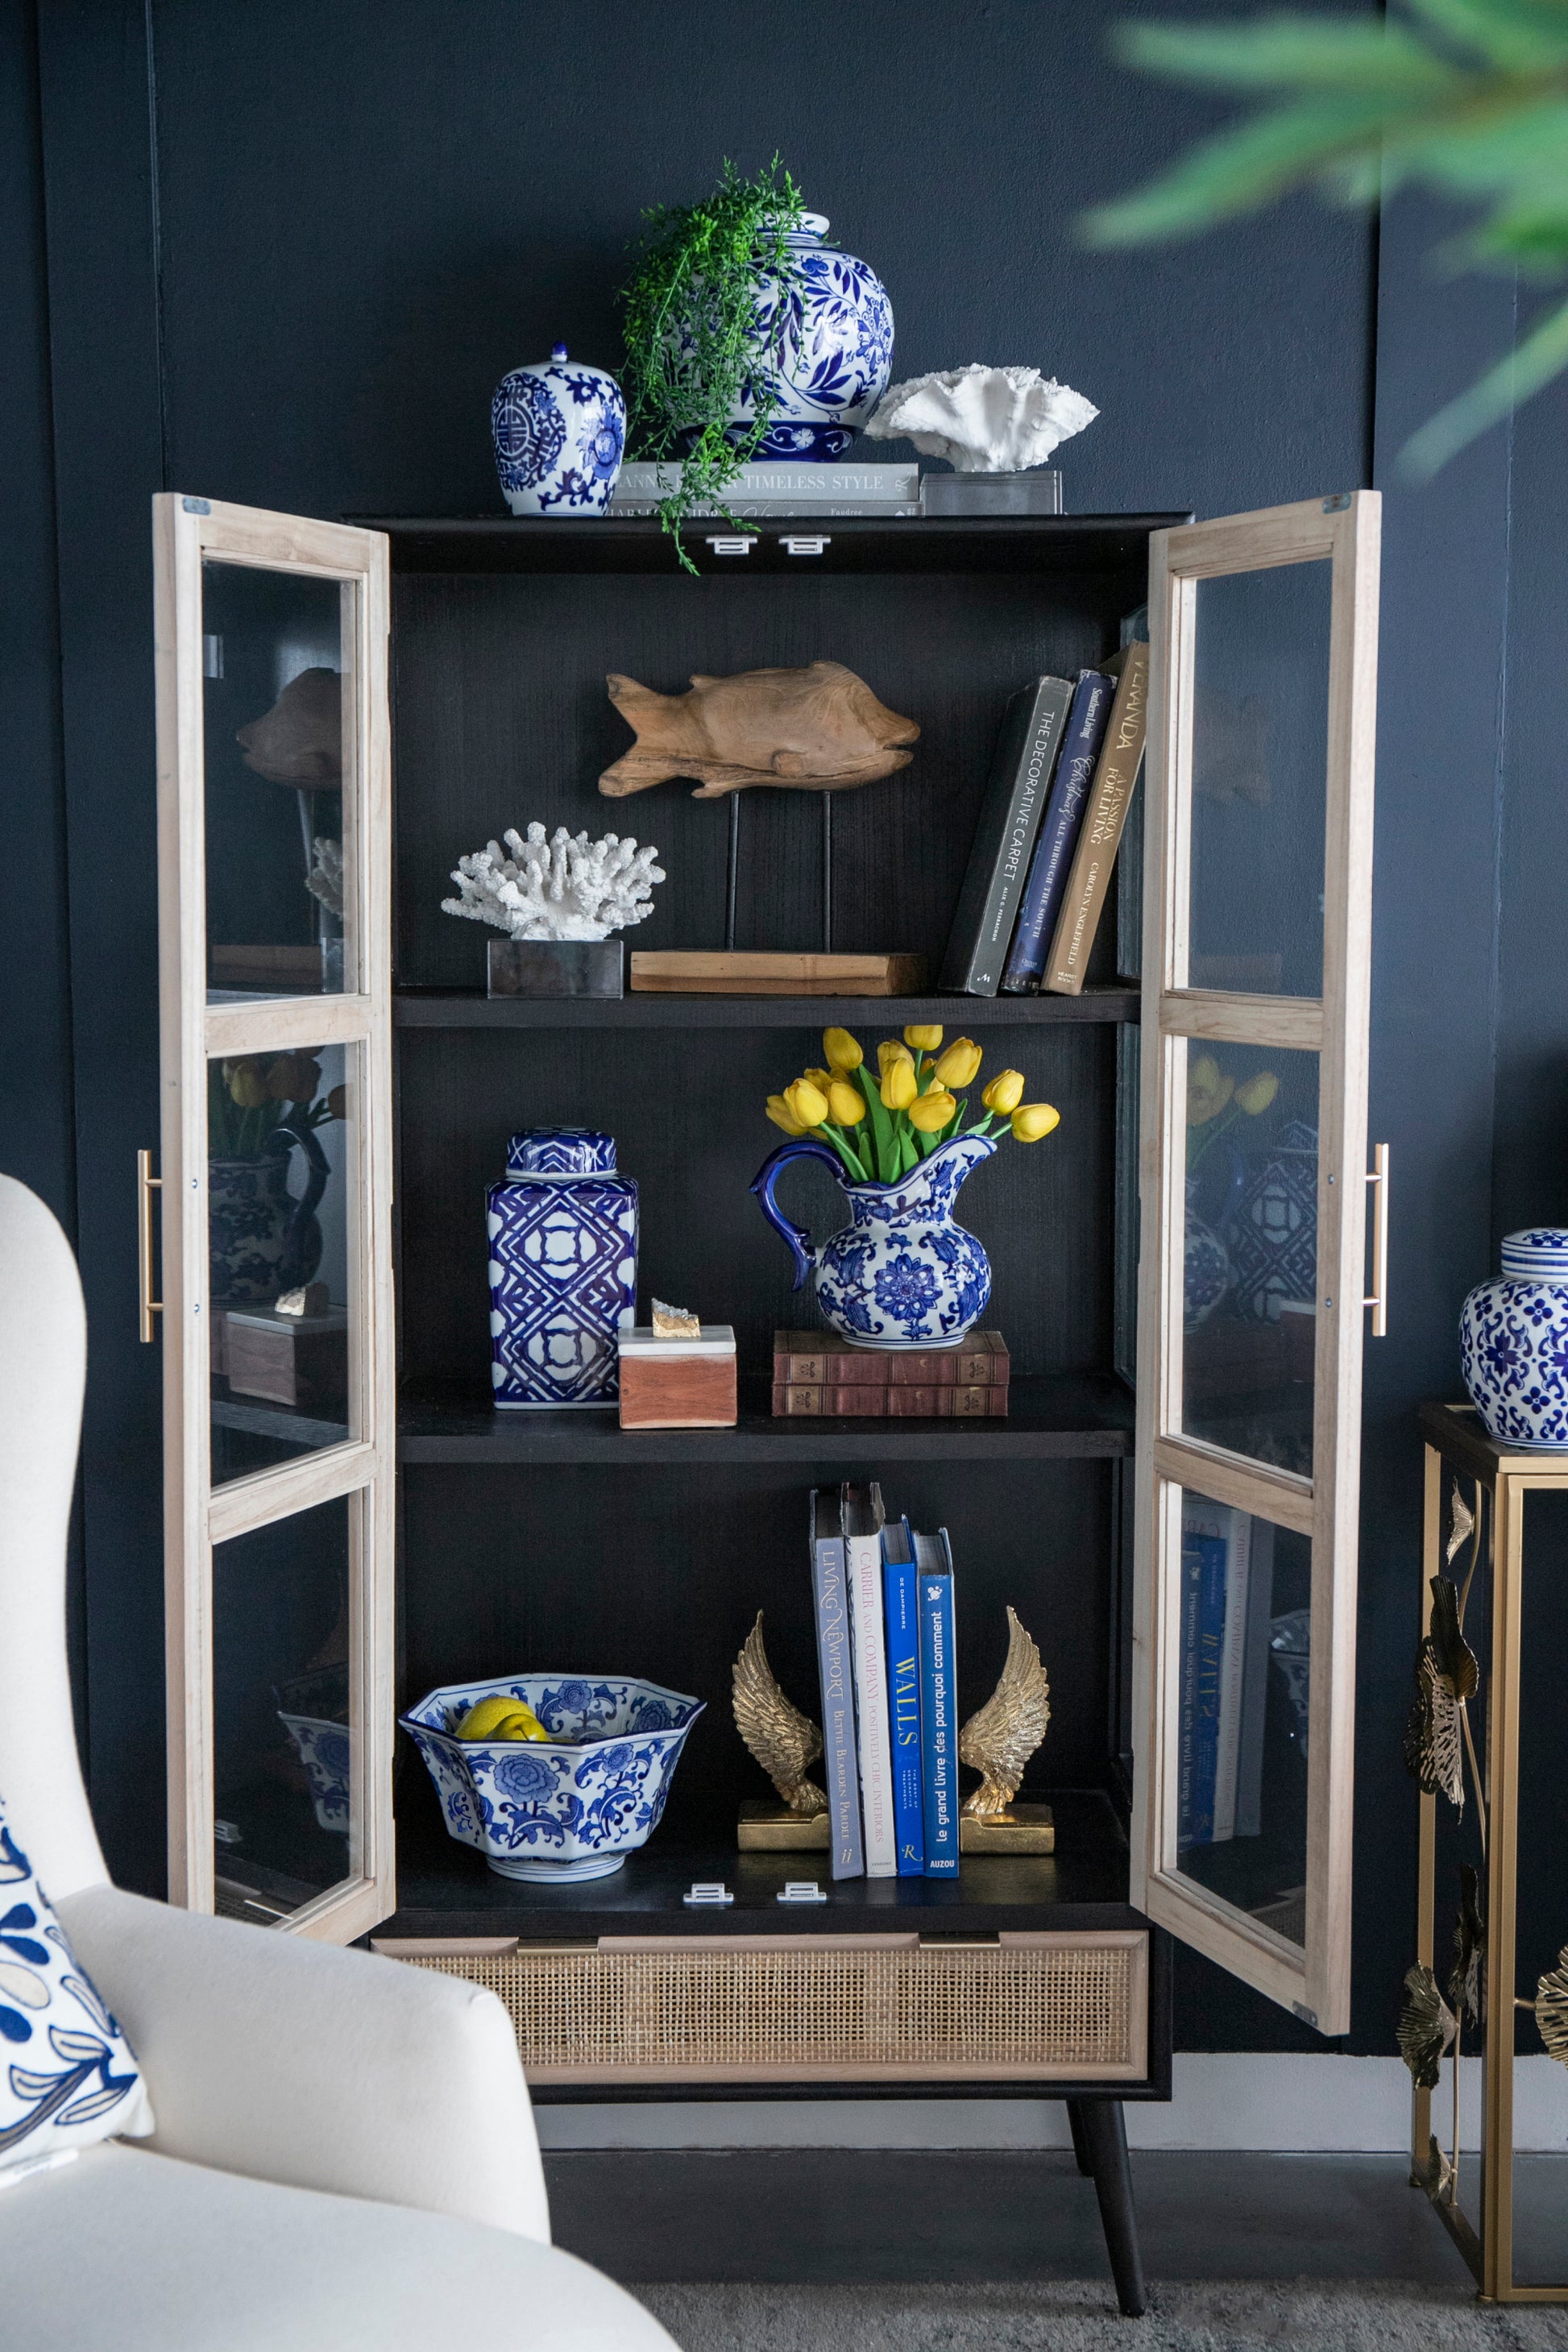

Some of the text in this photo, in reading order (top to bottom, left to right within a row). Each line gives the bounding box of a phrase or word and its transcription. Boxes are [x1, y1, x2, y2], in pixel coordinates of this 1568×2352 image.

[745, 475, 826, 489] TIMELESS
[832, 475, 884, 489] STYLE
[831, 508, 863, 516] Faudree
[1080, 687, 1103, 739] Southern Living
[1003, 711, 1055, 881] THE DECORATIVE CARPET
[1059, 755, 1095, 823] Christmas
[1090, 767, 1119, 844] FOR LIVING
[1103, 788, 1125, 842] PASSION
[1032, 820, 1067, 939] ALL THROUGH THE SOUTH
[1068, 862, 1099, 964] CAROLYN ENGLEFIELD
[820, 1551, 844, 1701] LIVING NEWPORT
[860, 1552, 884, 1843] CARRIER AND COMPANY POSITIVELY CHIC INTERIORS
[895, 1655, 918, 1746] WALLS
[931, 1612, 950, 1843] le grand livre des pourquoi comment
[833, 1710, 851, 1840] BETTIE BEARDEN PARDEE
[930, 1860, 955, 1869] AUZOU
